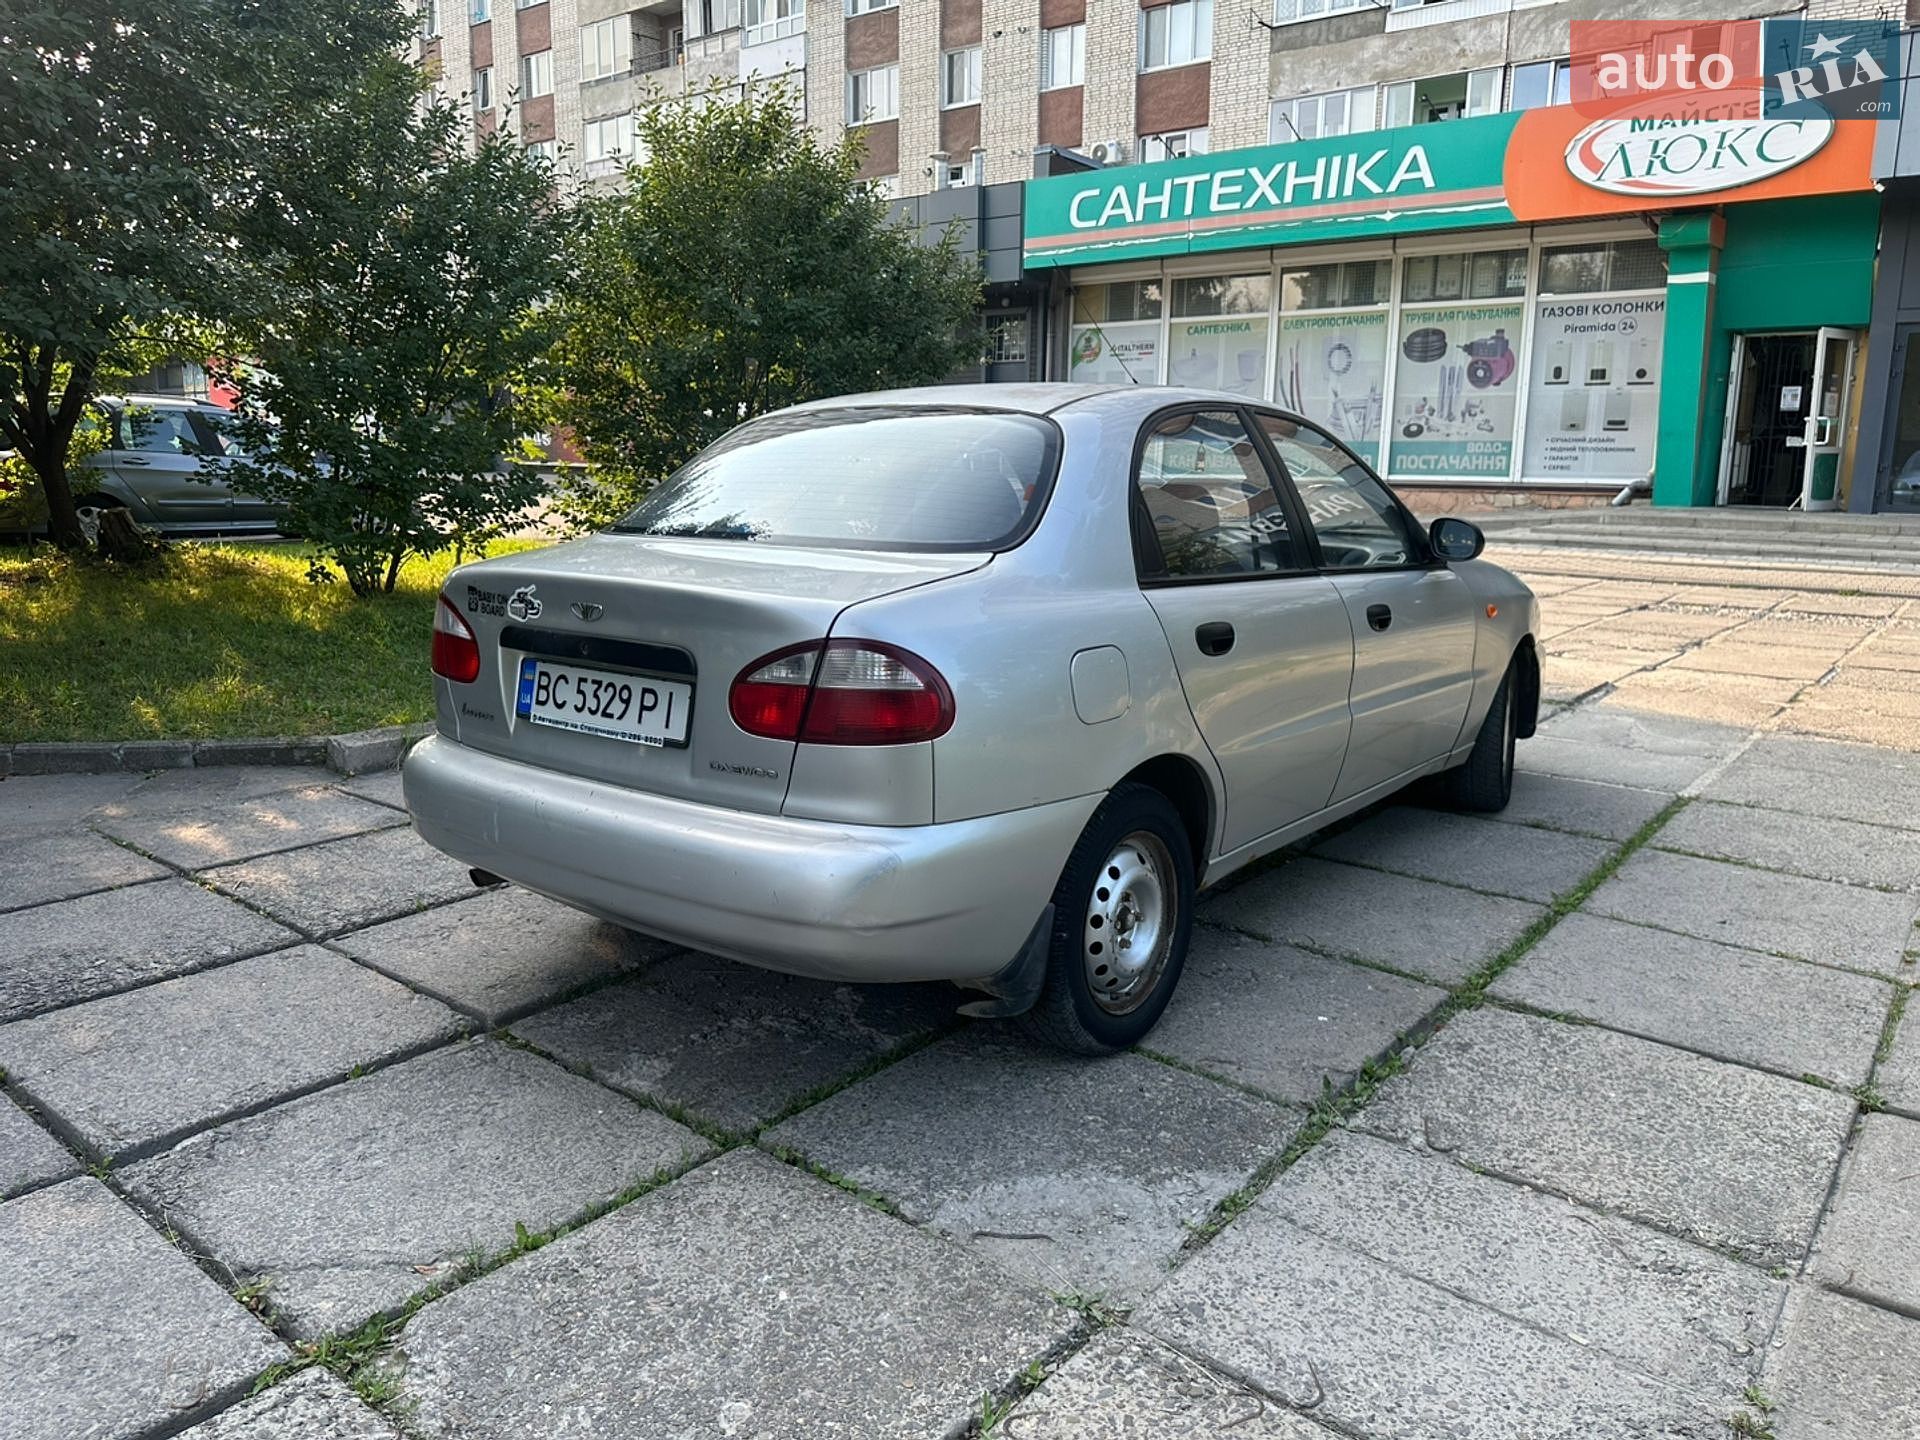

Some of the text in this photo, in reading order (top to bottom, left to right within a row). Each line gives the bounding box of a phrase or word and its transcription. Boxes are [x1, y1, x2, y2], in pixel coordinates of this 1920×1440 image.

[1630, 98, 1783, 134] МАЙСТЕР
[1593, 120, 1803, 182] ЛЮКС
[1069, 145, 1435, 228] САНТЕХНІКА
[1542, 300, 1664, 318] ГАЗОВІ КОЛОНКИ
[1406, 312, 1435, 324] ТРУБИ
[1437, 311, 1455, 322] ДЛЯ
[1187, 322, 1252, 336] САНТЕХНІКА
[1564, 321, 1635, 333] Piramida 24
[1466, 442, 1506, 453] ВОДО-
[1396, 454, 1507, 470] ПОСТАЧАННЯ
[480, 602, 505, 617] BOARD
[522, 691, 531, 705] UA
[535, 671, 674, 729] BC 5329 PI
